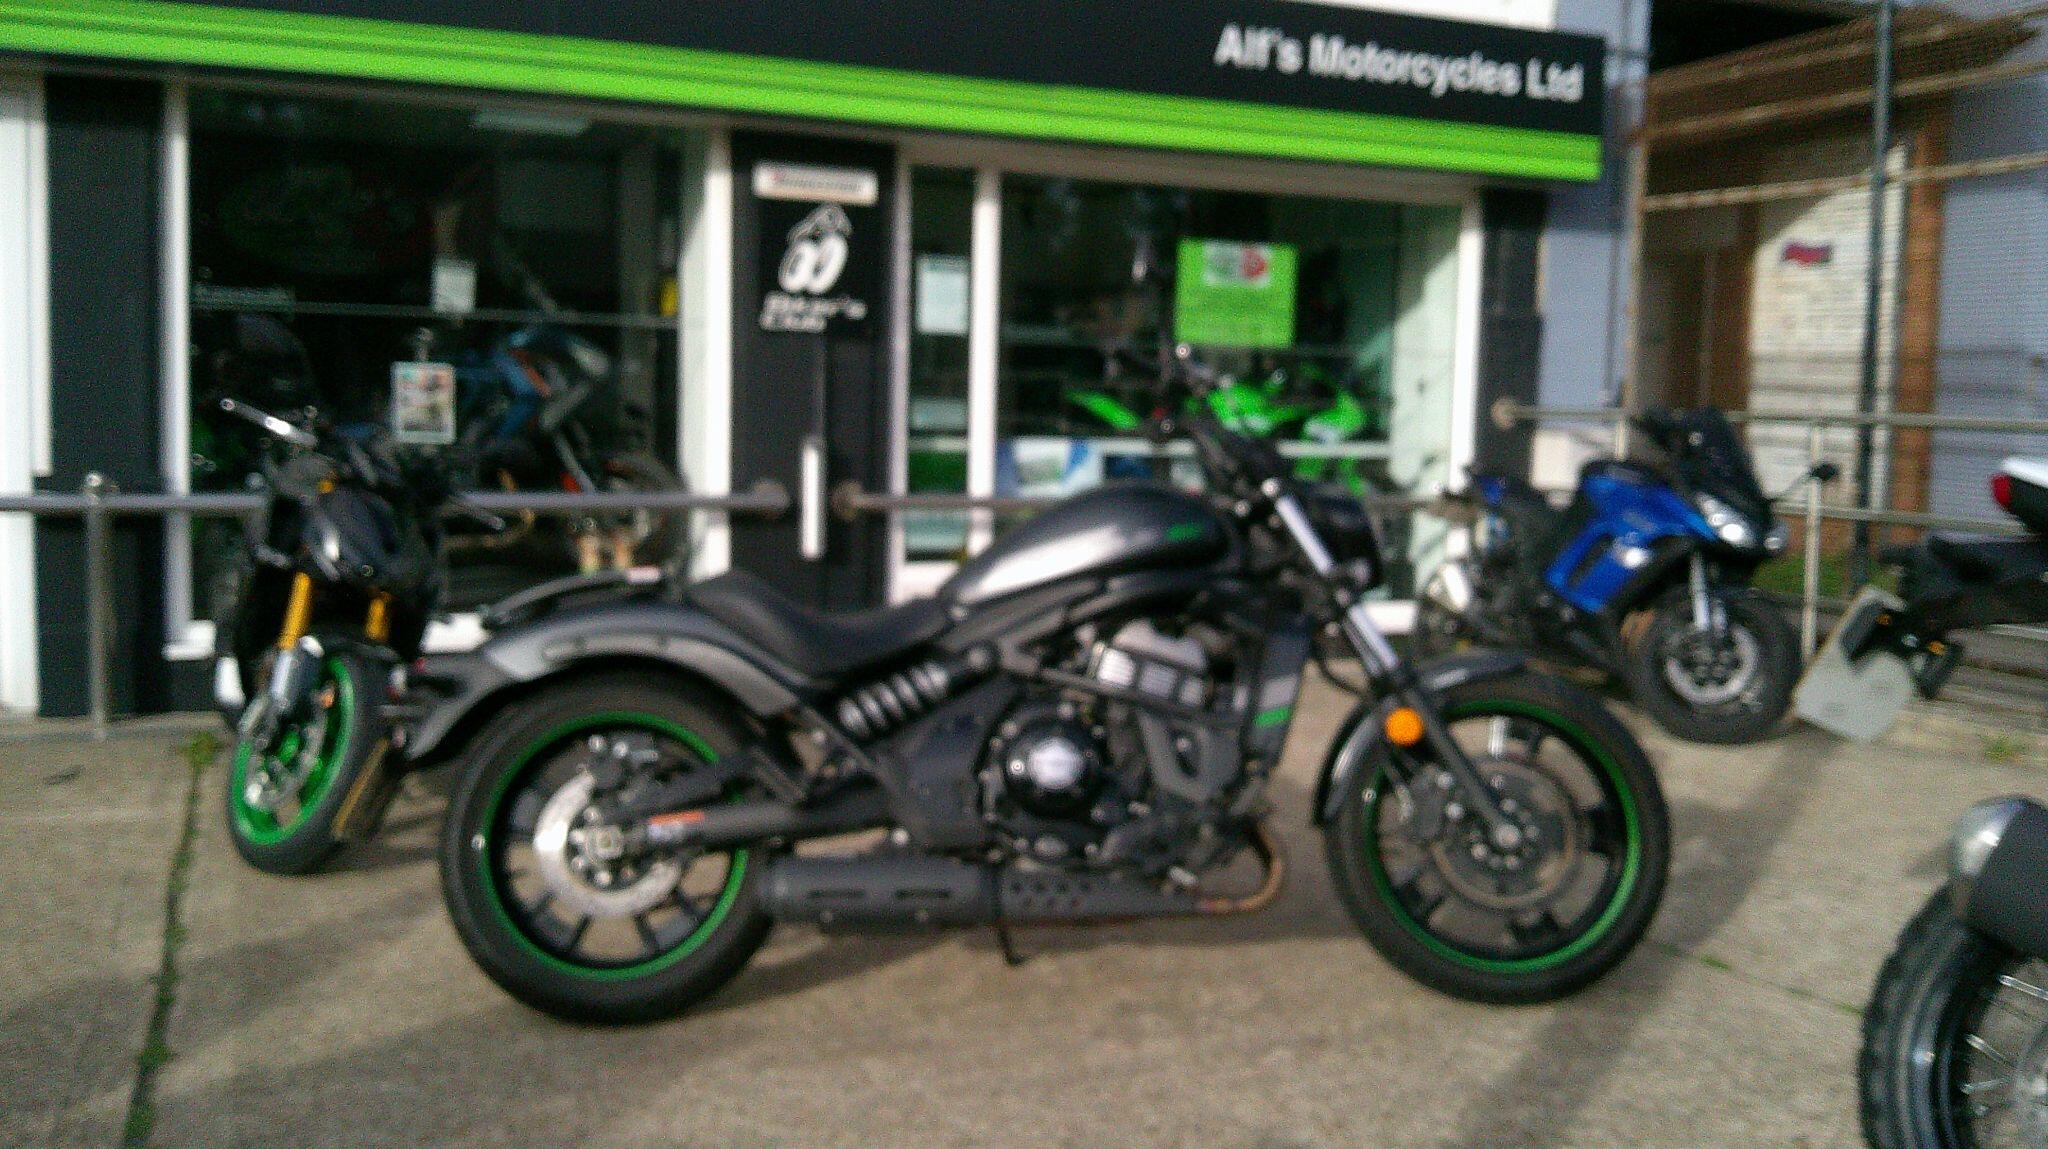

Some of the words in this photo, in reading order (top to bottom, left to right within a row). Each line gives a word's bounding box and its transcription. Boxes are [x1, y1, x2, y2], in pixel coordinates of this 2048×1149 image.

[1214, 22, 1301, 74] Alf's
[1309, 33, 1521, 98] Motorcycles
[1526, 57, 1584, 102] Ltd
